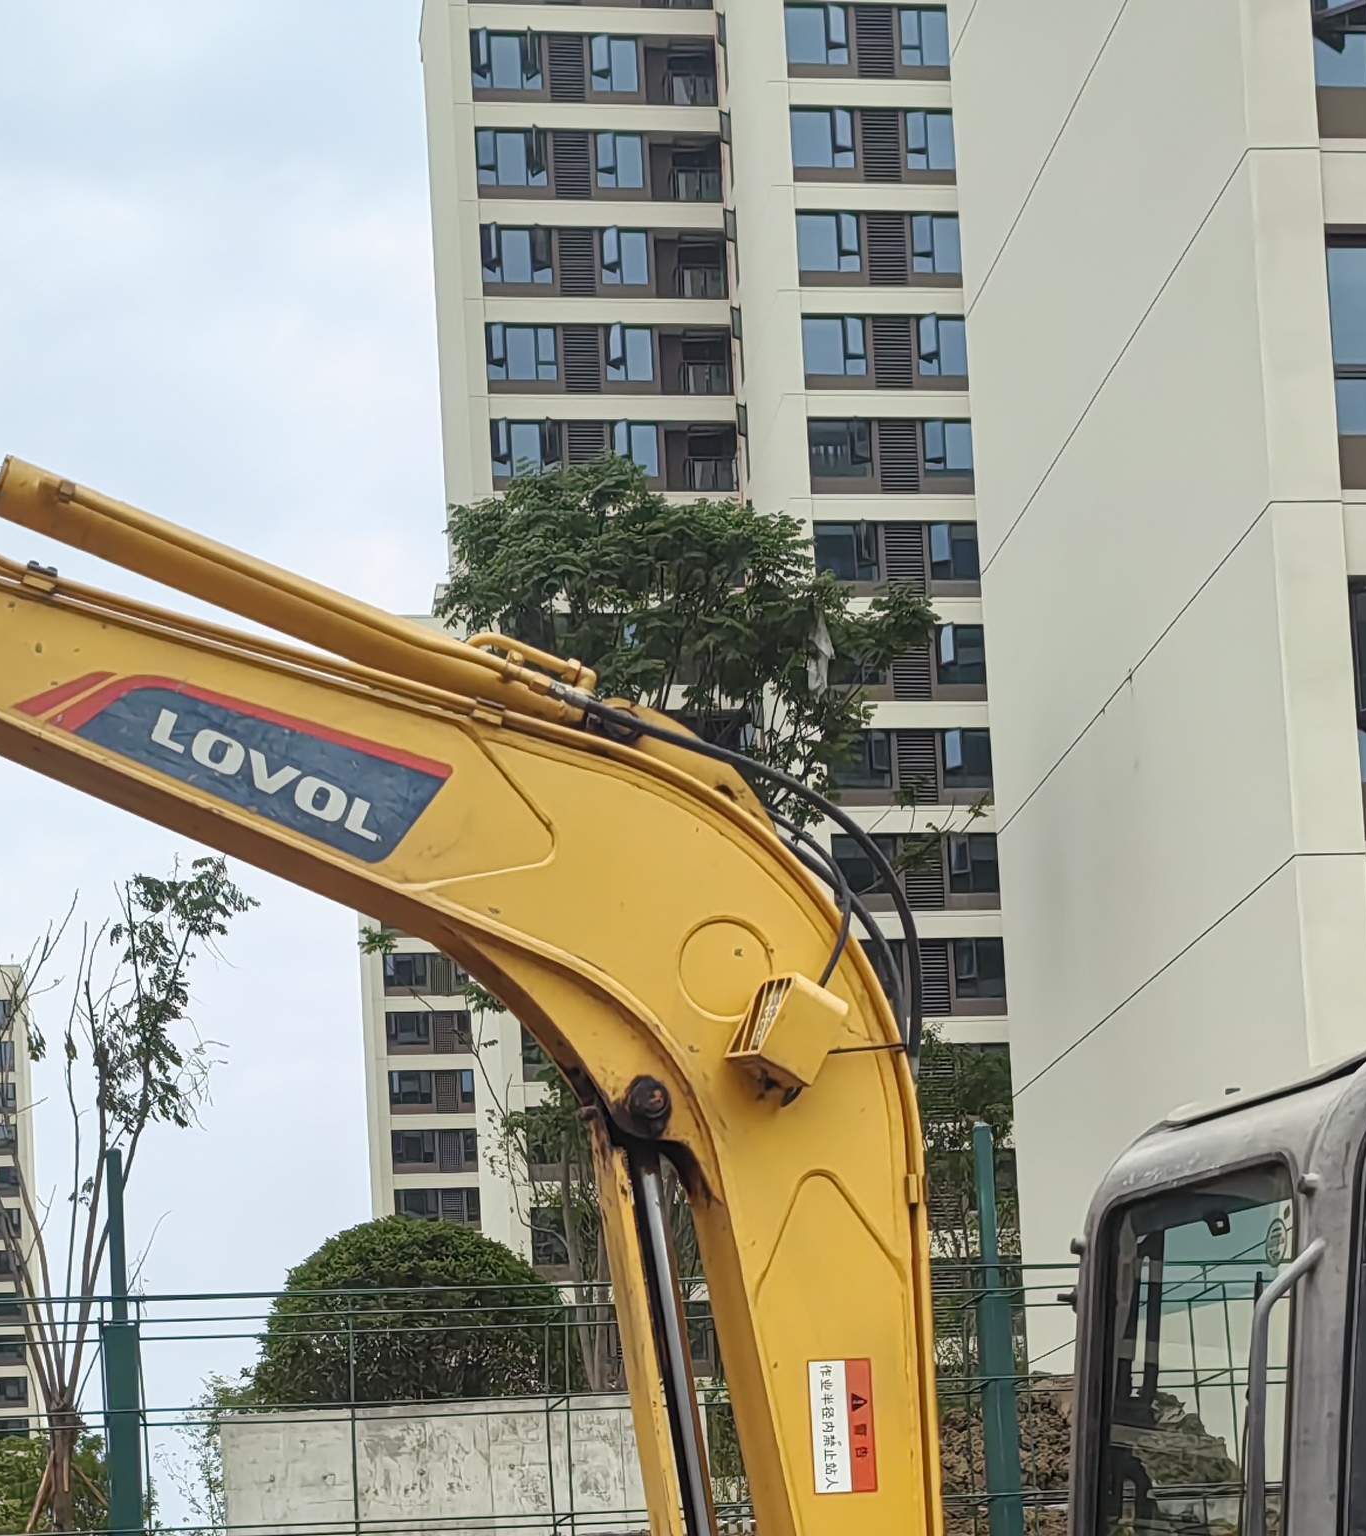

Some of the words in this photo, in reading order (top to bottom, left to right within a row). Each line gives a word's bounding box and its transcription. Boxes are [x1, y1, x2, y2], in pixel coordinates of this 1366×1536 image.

[151, 708, 378, 843] LOVOL
[819, 1364, 840, 1490] 作业半径内禁止站人
